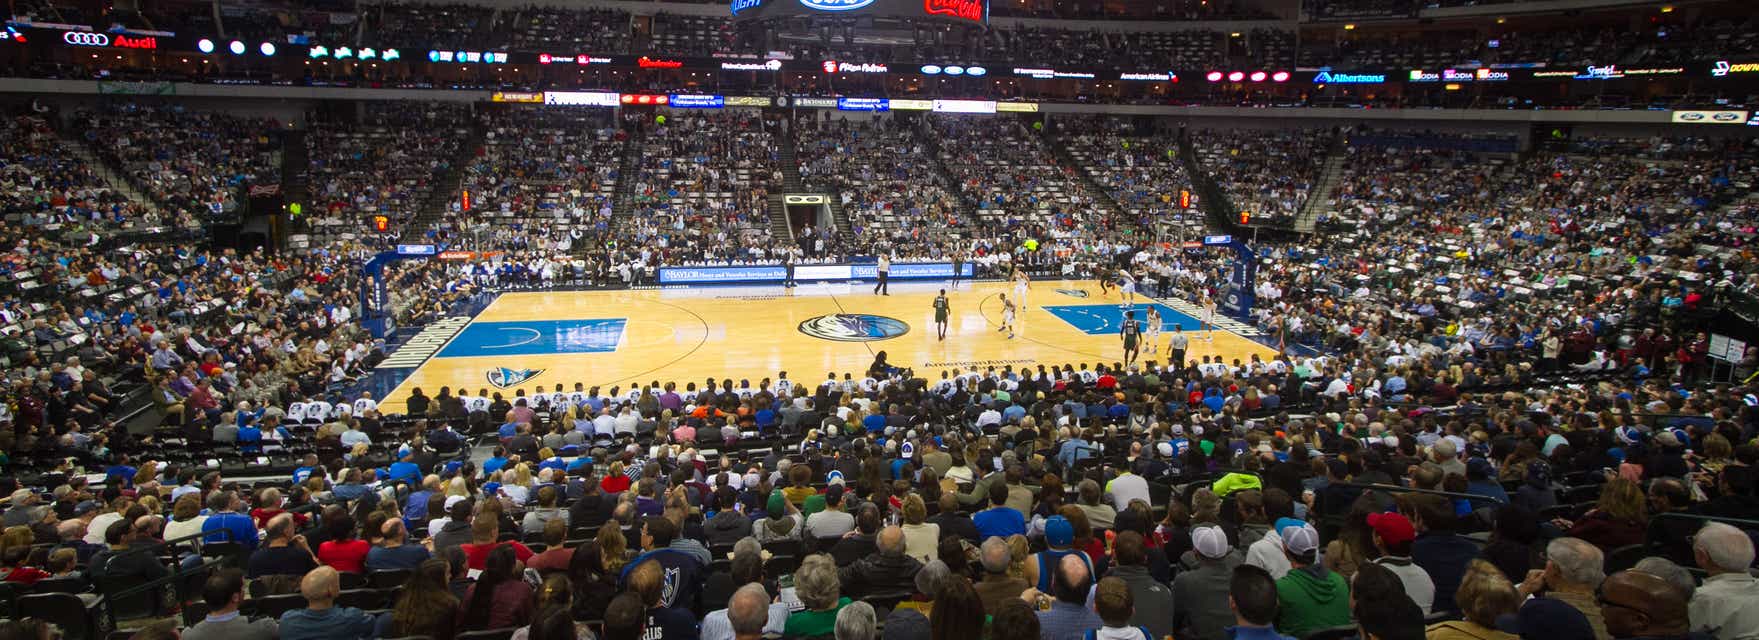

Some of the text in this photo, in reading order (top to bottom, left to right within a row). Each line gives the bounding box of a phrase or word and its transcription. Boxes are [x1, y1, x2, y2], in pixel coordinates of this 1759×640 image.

[114, 35, 157, 48] Audi
[1333, 74, 1385, 83] Albertsons
[670, 270, 700, 278] BAYLOR
